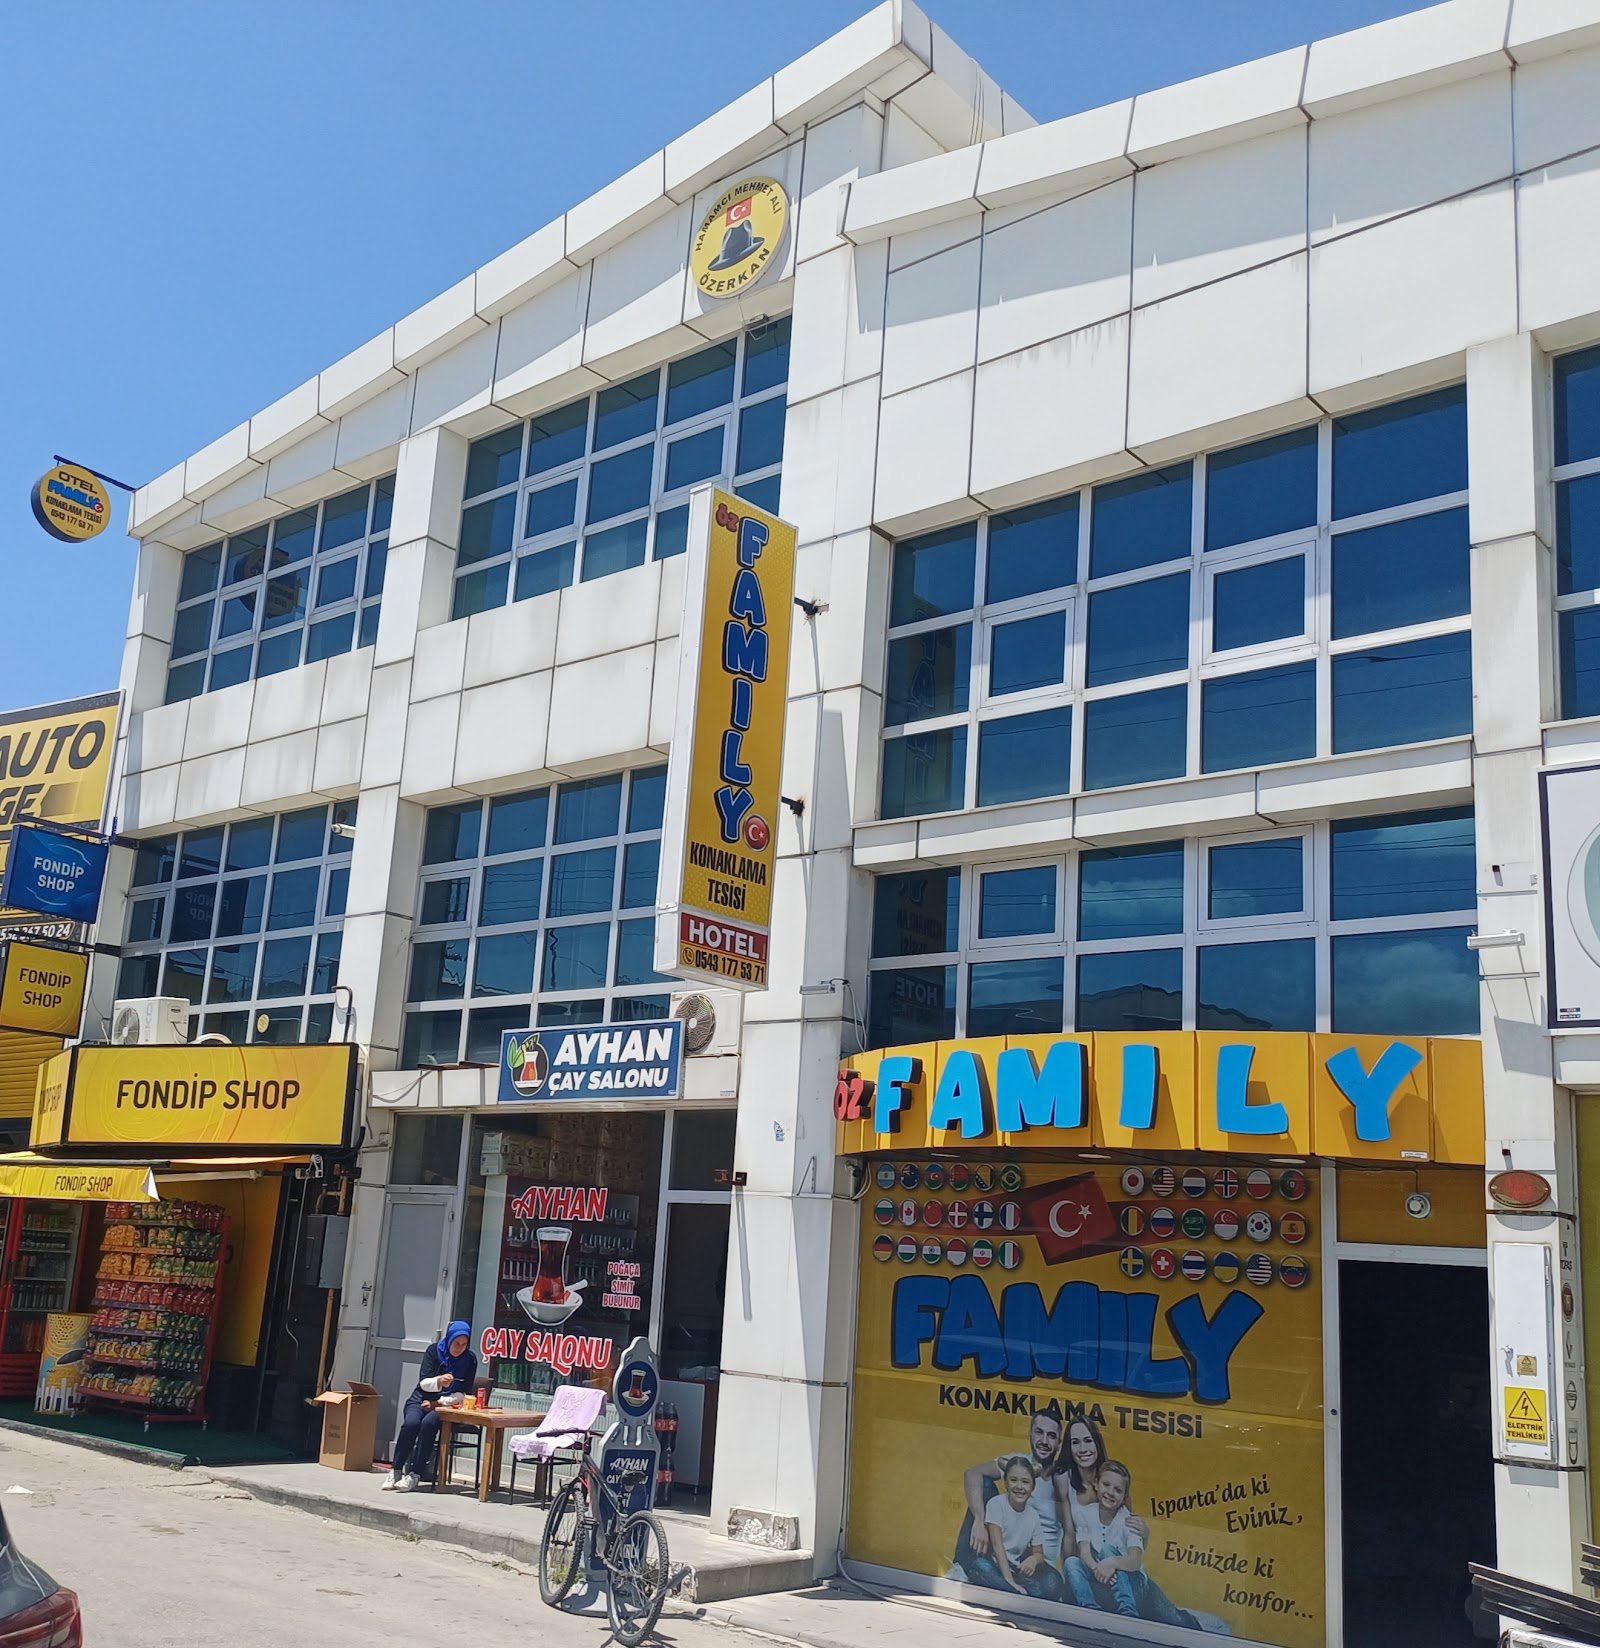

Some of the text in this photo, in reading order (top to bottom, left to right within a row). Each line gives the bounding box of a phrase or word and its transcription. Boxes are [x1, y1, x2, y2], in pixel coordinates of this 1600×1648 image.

[695, 194, 732, 251] HAMAMCI
[734, 181, 774, 196] MEHMET
[699, 248, 770, 292] ÖZERKAN
[47, 479, 101, 510] FAMILY
[58, 470, 98, 495] OTEL
[714, 516, 770, 843] FAMILY
[33, 856, 85, 879] FONDİP
[689, 841, 767, 886] KONAKLAMA
[37, 874, 75, 893] SHOP
[707, 878, 747, 912] TESİSİ
[56, 923, 71, 938] 24
[688, 918, 760, 960] HOTEL
[18, 968, 72, 989] FONDİP
[695, 948, 765, 984] 0543 177 53 71
[23, 990, 62, 1009] SHOP
[552, 1027, 673, 1066] AYHAN
[116, 1072, 300, 1110] FONDİP SHOP
[548, 1067, 669, 1097] ÇAY SALONU
[874, 1041, 1424, 1142] FAMILY
[87, 1176, 114, 1193] SHOP
[511, 1185, 608, 1222] AYHAN
[606, 1259, 641, 1278] POĞAÇA
[601, 1293, 641, 1311] BULUNUR
[610, 1278, 636, 1295] SİMİT
[480, 1326, 612, 1376] ÇAY SALONU
[890, 1274, 1265, 1404] FAMILY
[939, 1384, 1203, 1439] KONAKLAMA TESİSİ
[1507, 1421, 1544, 1432] ELEKTRİK
[1506, 1430, 1546, 1441] TEHLİKESİ
[609, 1457, 649, 1471] AYHAN
[1251, 1474, 1271, 1497] ki
[1164, 1541, 1275, 1579] Evinizde ki
[1223, 1583, 1314, 1620] konfor...
